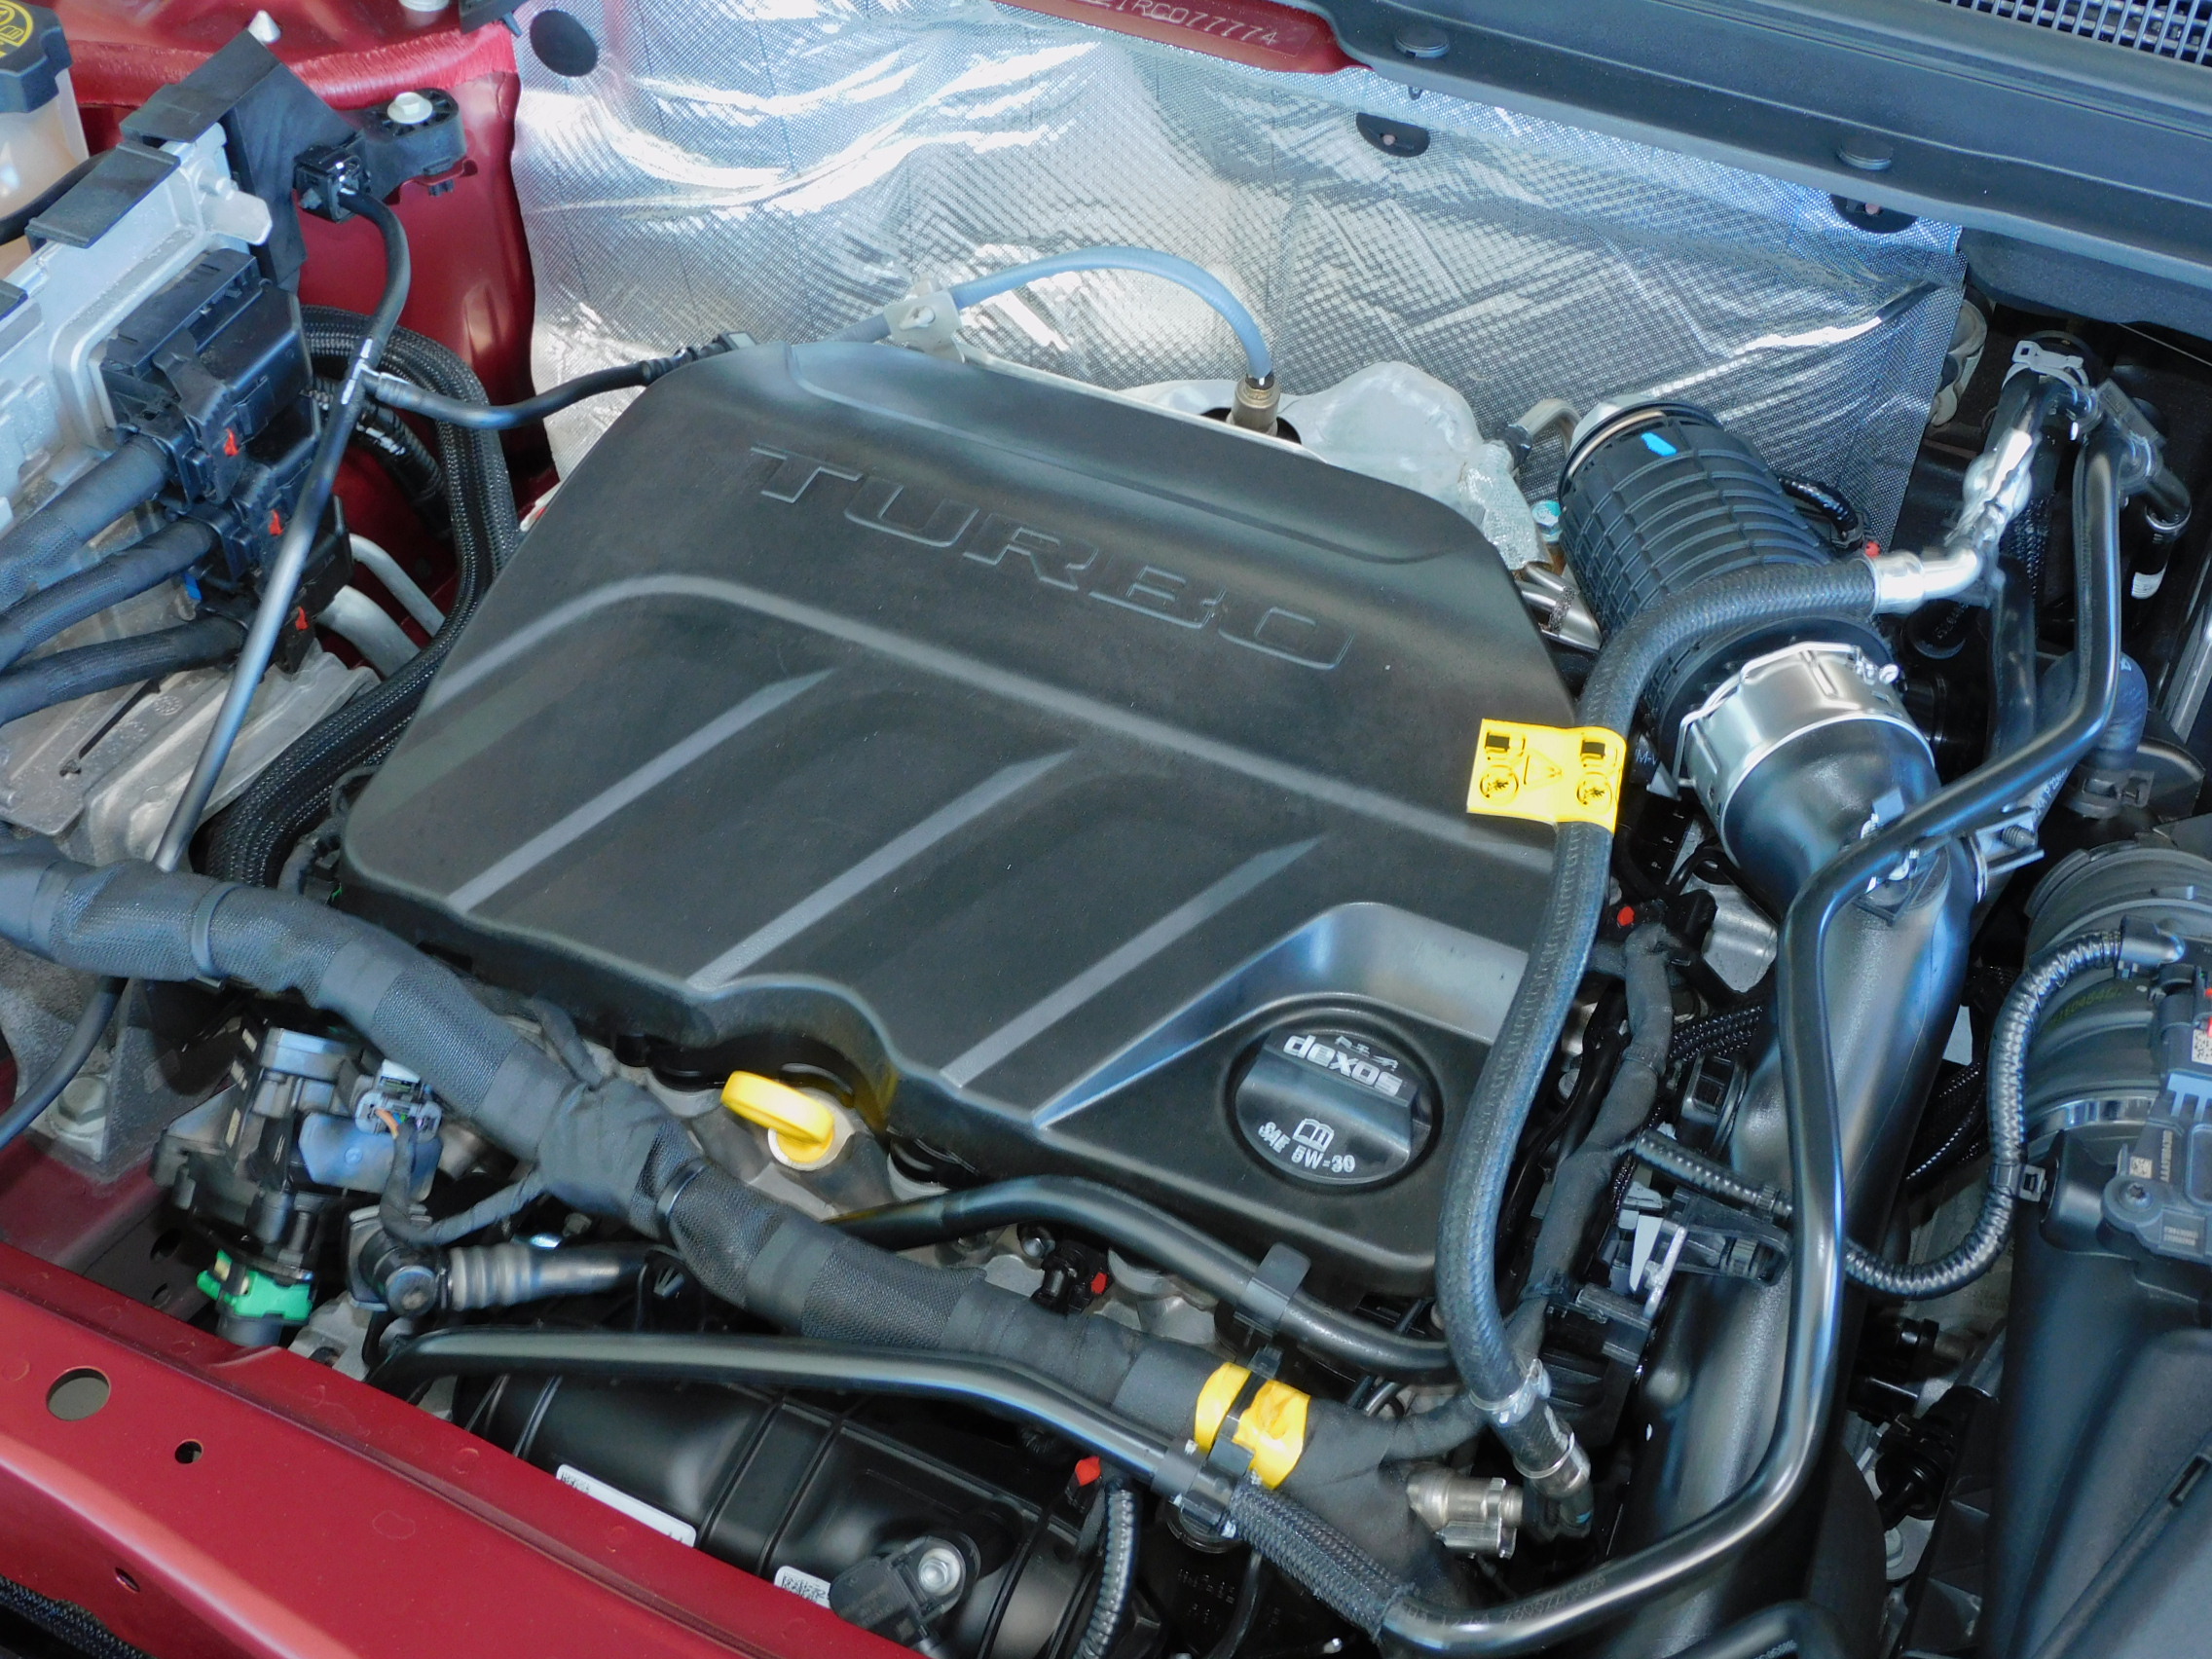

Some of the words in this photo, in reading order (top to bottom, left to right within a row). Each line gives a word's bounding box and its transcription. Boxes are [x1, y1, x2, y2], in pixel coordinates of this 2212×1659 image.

[752, 443, 1354, 671] TURBO
[1283, 1034, 1403, 1097] dexos
[1258, 1121, 1291, 1154] SAE
